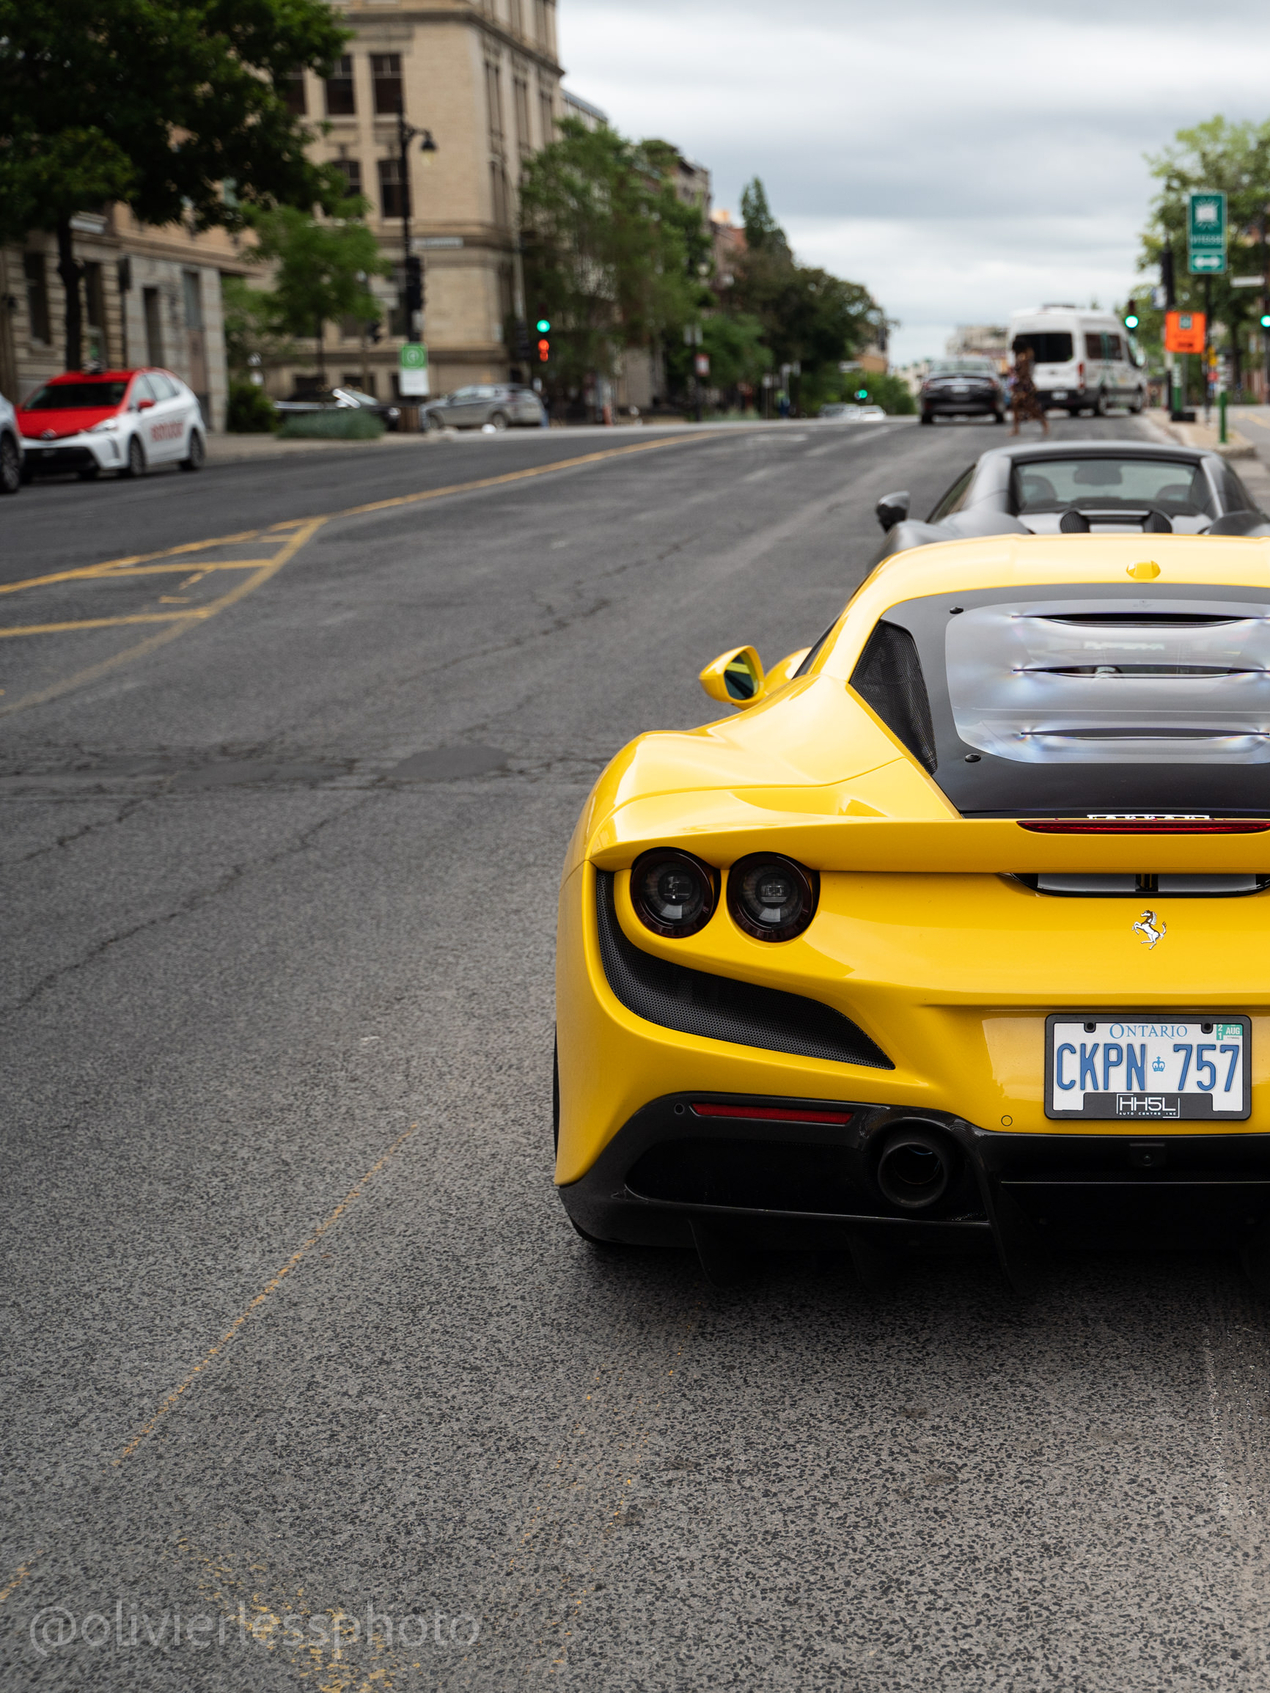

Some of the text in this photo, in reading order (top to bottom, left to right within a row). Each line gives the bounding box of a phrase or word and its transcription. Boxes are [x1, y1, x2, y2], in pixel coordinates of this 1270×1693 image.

[1226, 1026, 1241, 1035] AUG
[1056, 1042, 1240, 1093] CKPN 757
